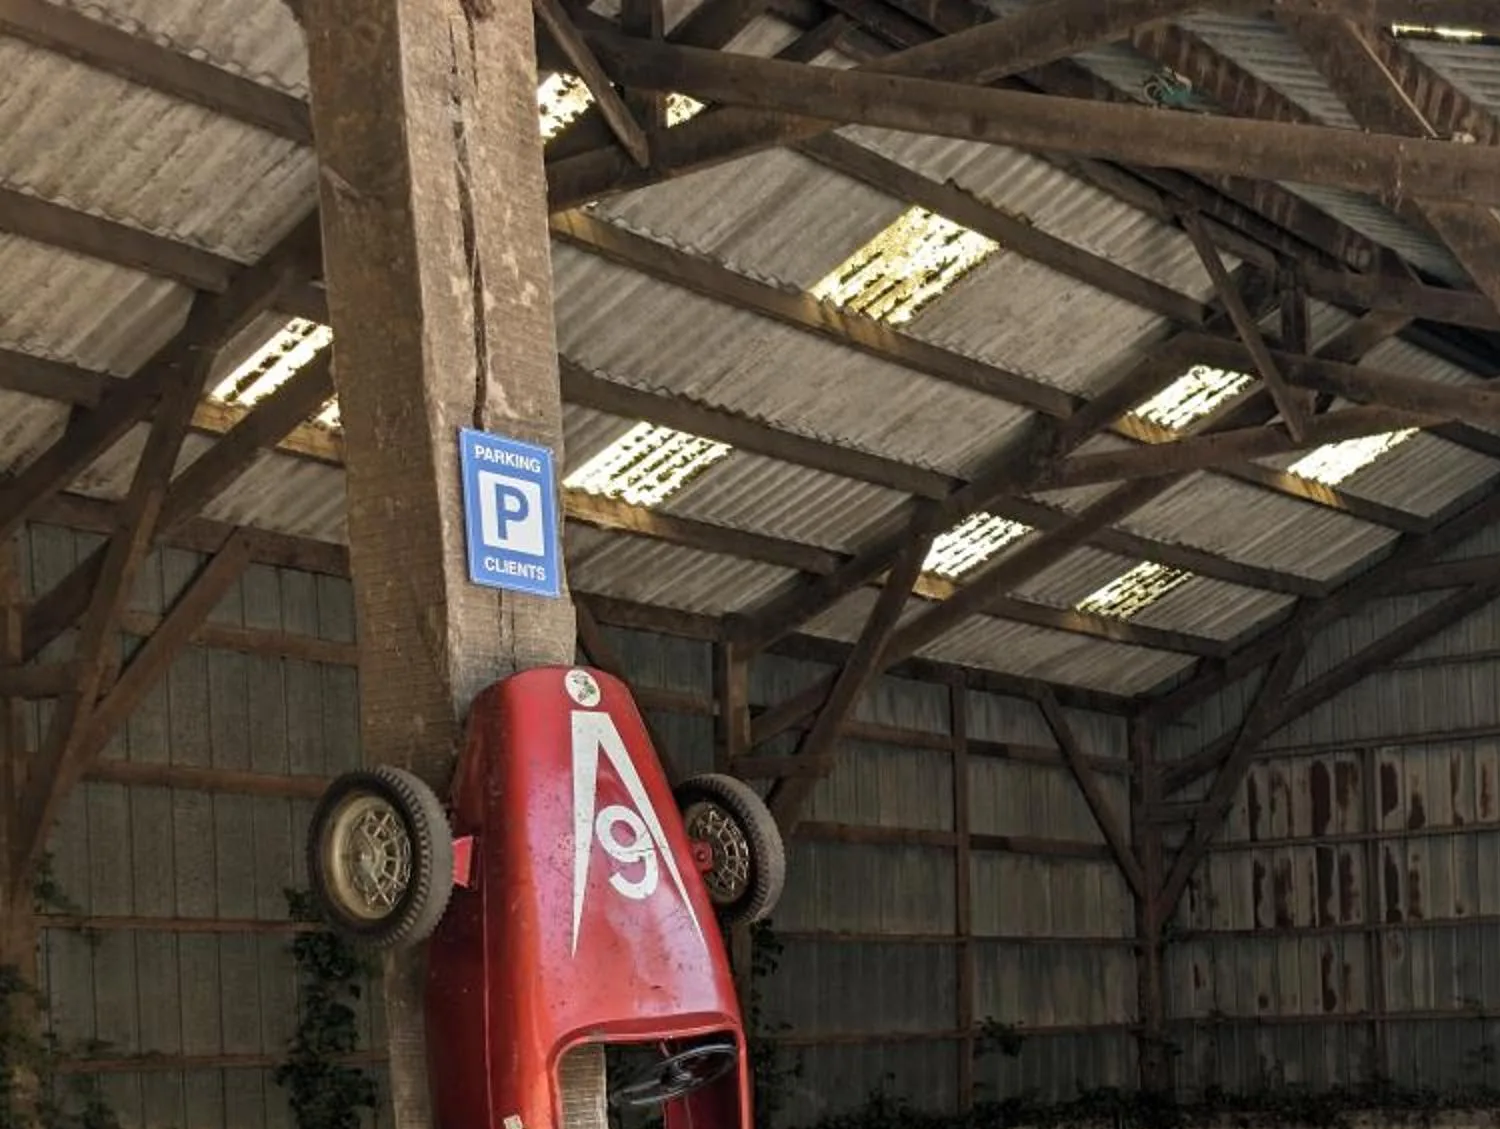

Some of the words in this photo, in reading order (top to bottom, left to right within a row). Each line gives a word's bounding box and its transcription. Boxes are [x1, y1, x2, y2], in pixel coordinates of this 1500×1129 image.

[474, 445, 541, 473] PARKING
[495, 483, 529, 541] P
[484, 557, 546, 581] CLIENTS
[596, 805, 659, 899] 9
